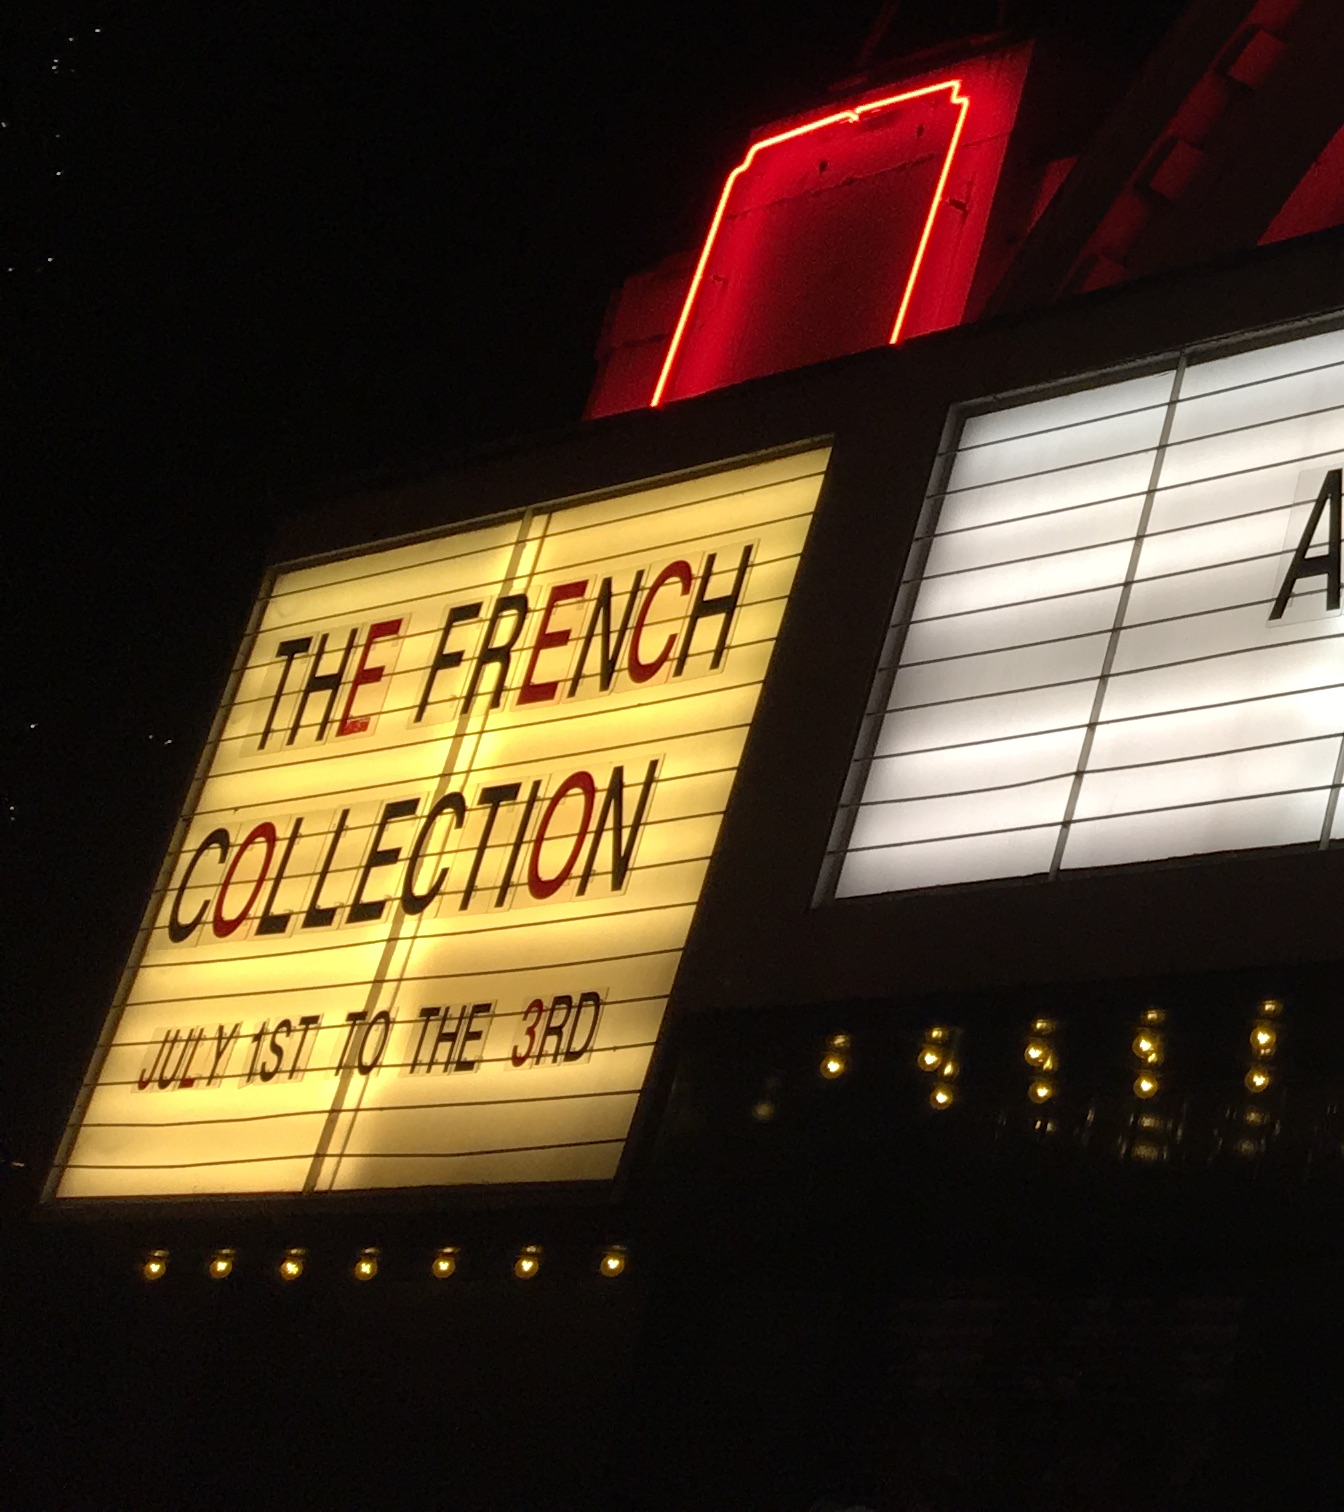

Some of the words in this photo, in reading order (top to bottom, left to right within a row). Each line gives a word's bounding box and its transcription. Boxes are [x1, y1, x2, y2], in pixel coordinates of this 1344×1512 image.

[258, 618, 403, 750] THE
[413, 543, 755, 722] FRENCH
[168, 759, 659, 943] COLLECTION
[136, 1028, 237, 1090] JULY
[247, 1015, 321, 1084] 1ST
[334, 1010, 391, 1076] TO
[410, 1002, 492, 1073] THE
[512, 991, 602, 1067] 3RD
